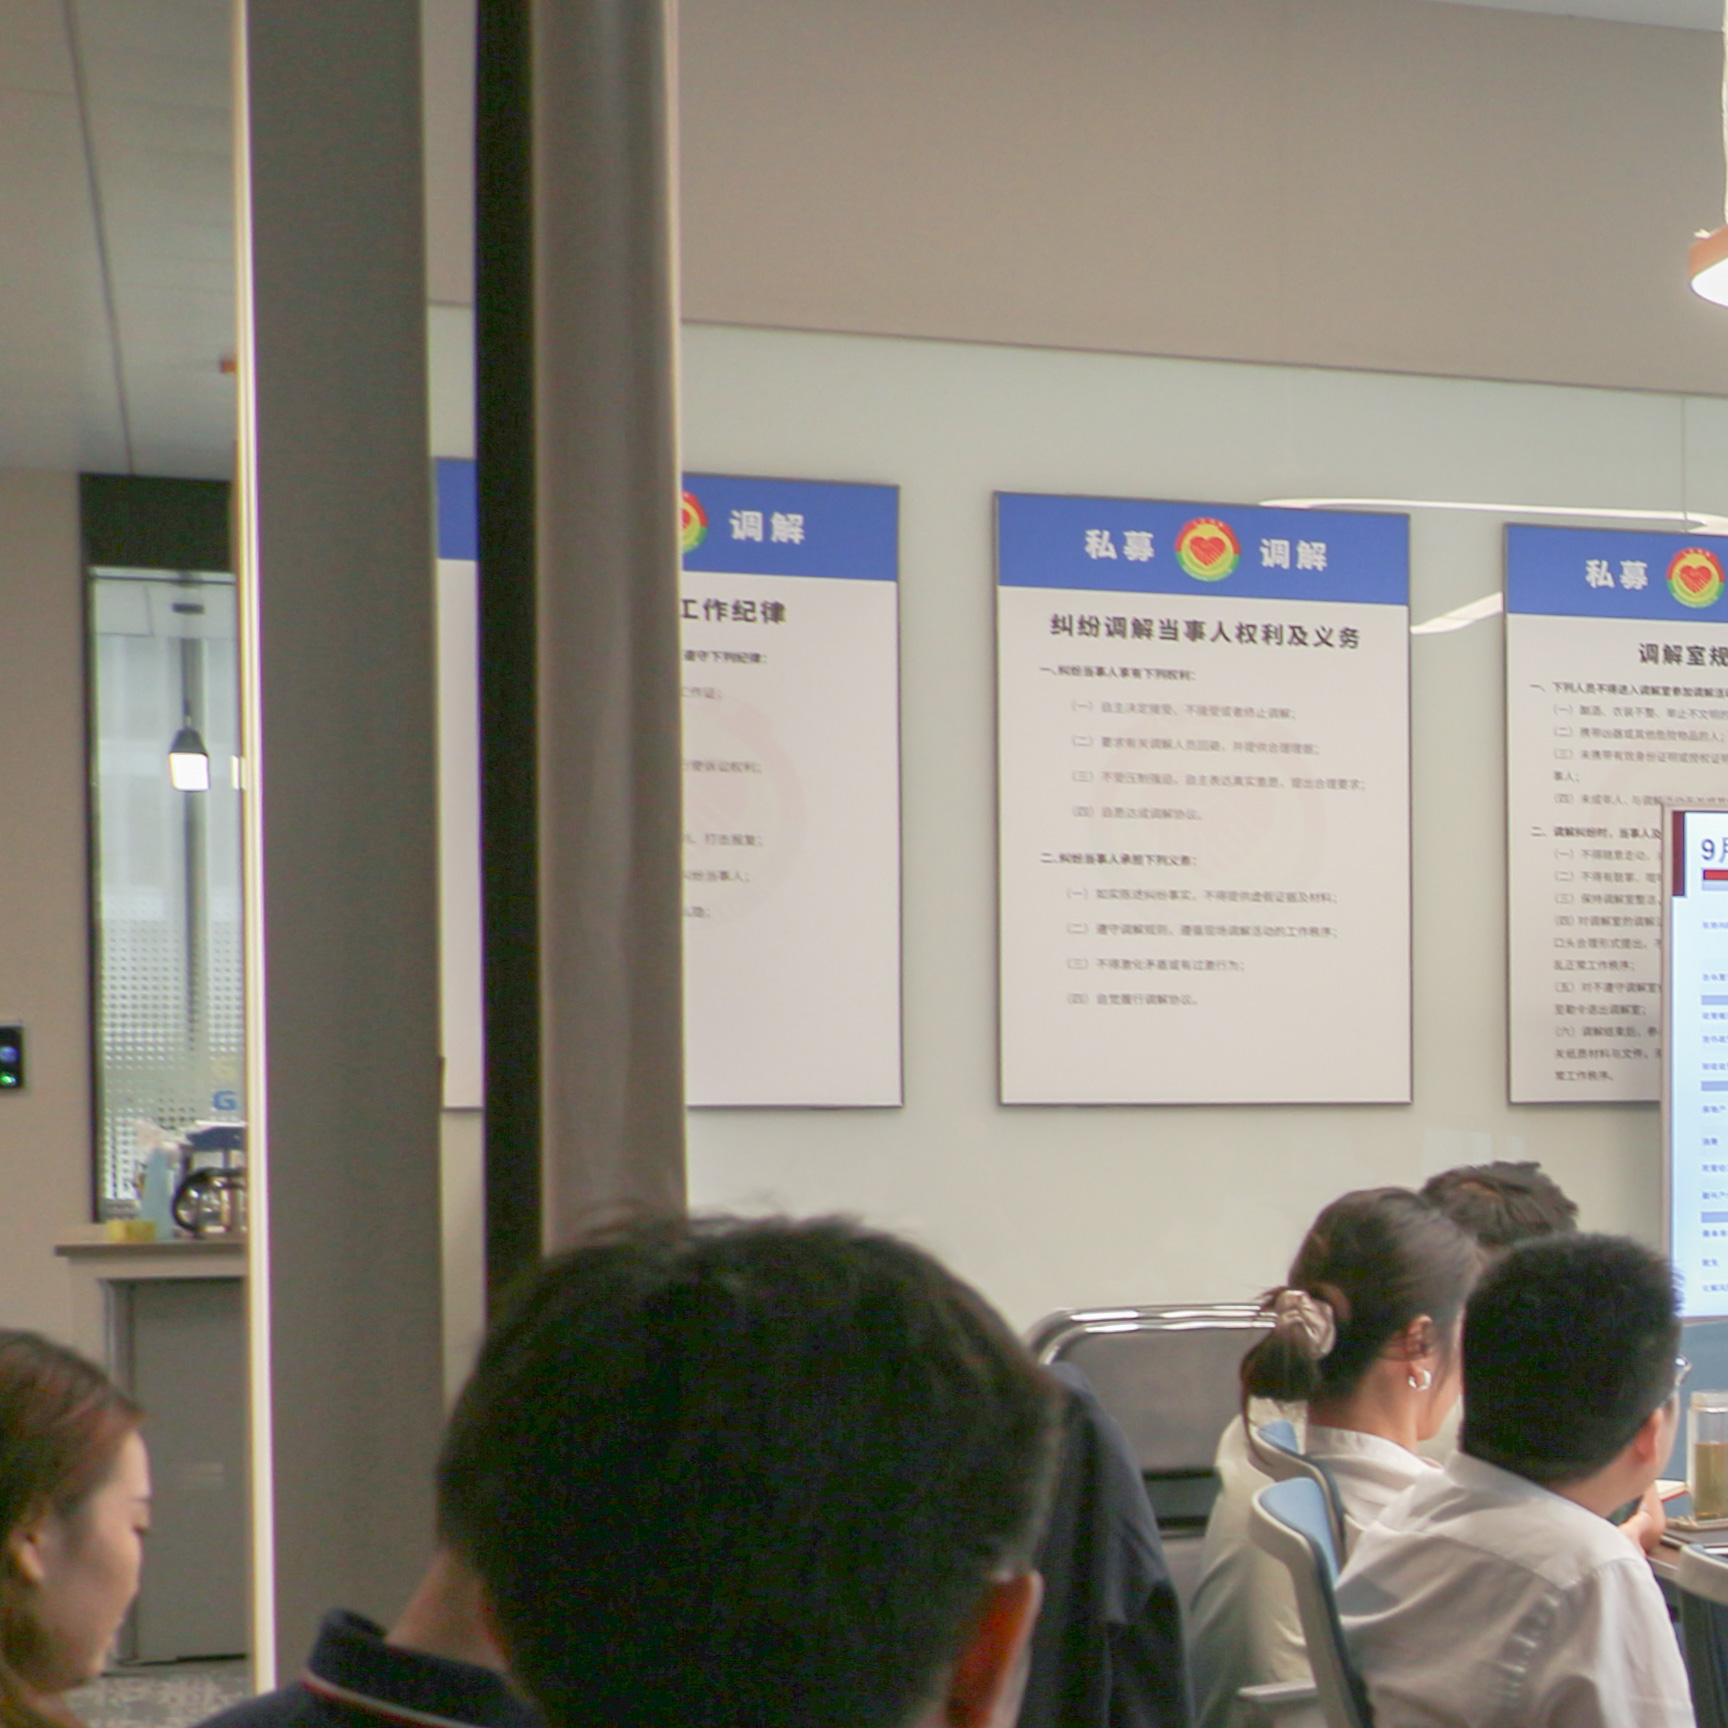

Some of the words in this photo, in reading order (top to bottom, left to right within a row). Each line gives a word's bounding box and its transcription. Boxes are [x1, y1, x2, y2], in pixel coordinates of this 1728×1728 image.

[729, 510, 805, 544] 调解
[1085, 529, 1154, 562] 私募
[1260, 539, 1327, 571] 调解
[1585, 559, 1648, 590] 私募
[681, 597, 787, 624] 工作纪律
[1051, 614, 1359, 649] 纠纷调解当事人权利及义务
